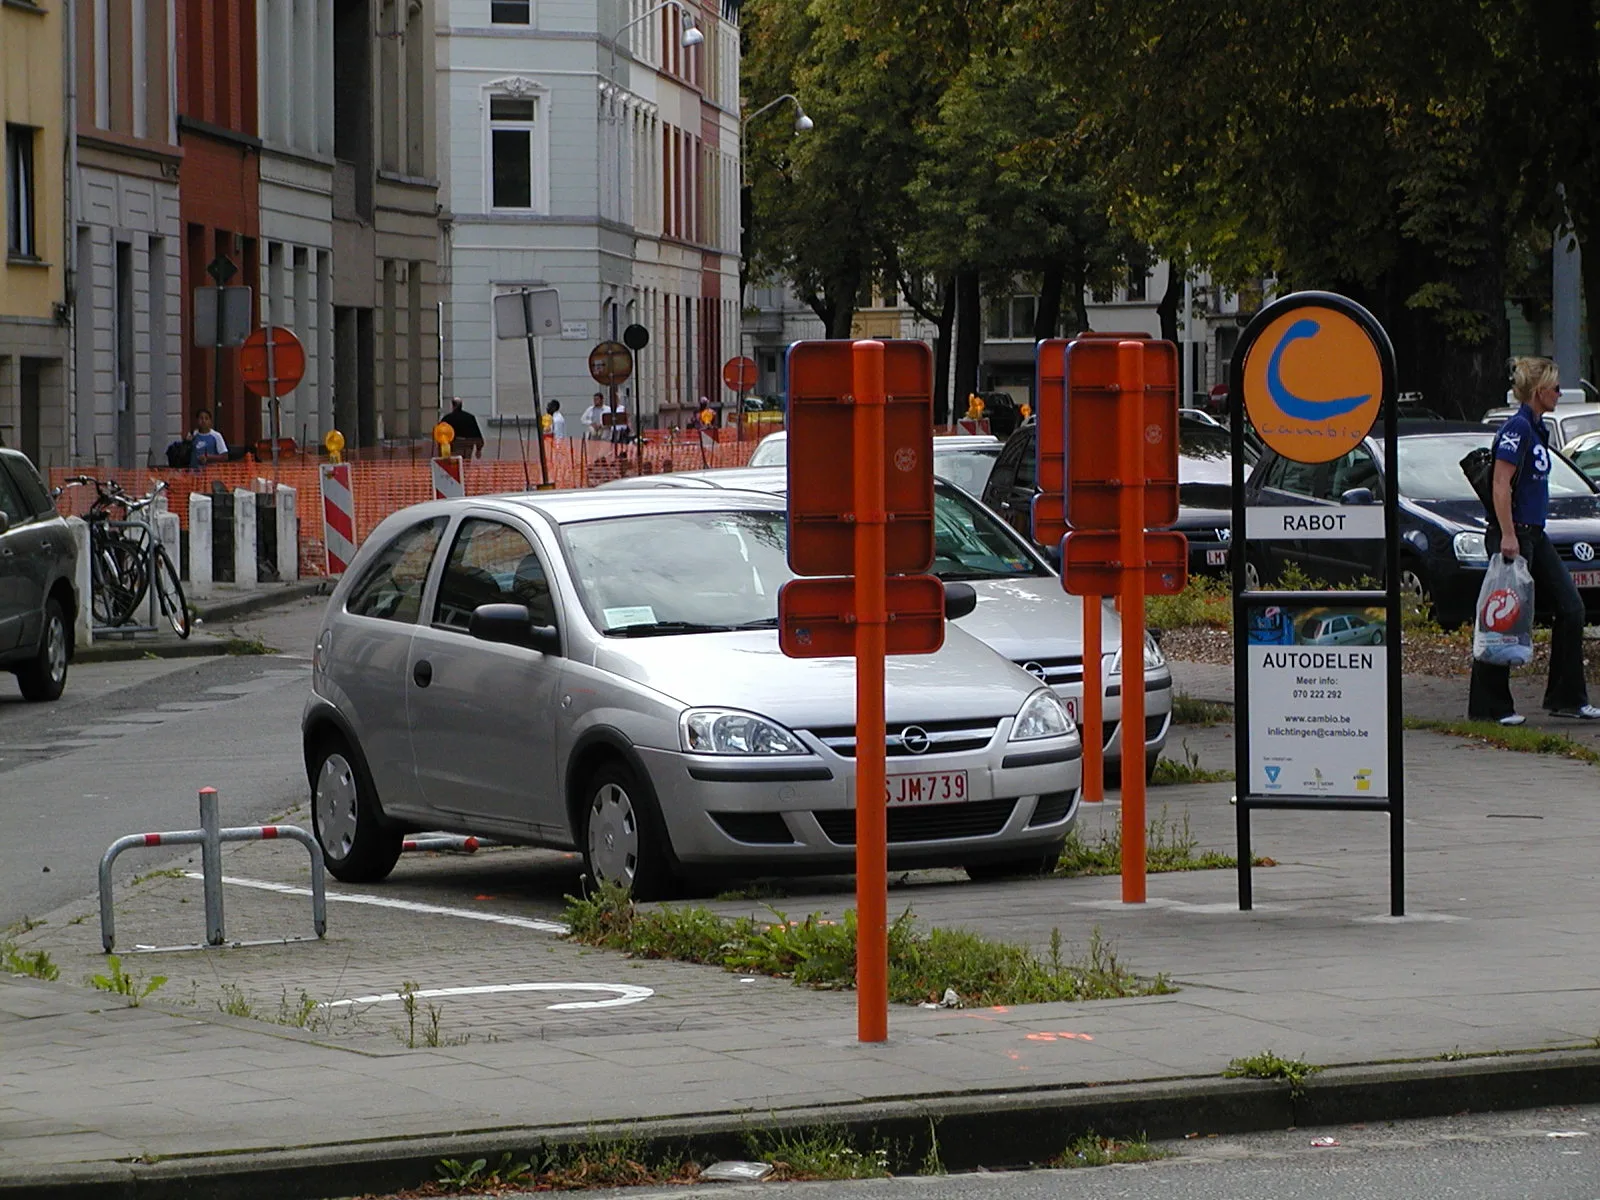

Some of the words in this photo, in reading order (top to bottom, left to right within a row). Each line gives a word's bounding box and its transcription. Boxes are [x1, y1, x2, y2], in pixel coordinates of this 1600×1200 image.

[1261, 423, 1362, 438] cambio
[1283, 515, 1346, 531] RABOT
[1263, 653, 1372, 669] AUTODELEN
[1296, 677, 1317, 685] Meer
[1319, 677, 1338, 685] info:
[1293, 690, 1308, 698] 070
[1310, 690, 1325, 698] 222
[1327, 690, 1342, 699] 292
[1285, 715, 1351, 723] www.cambio.be
